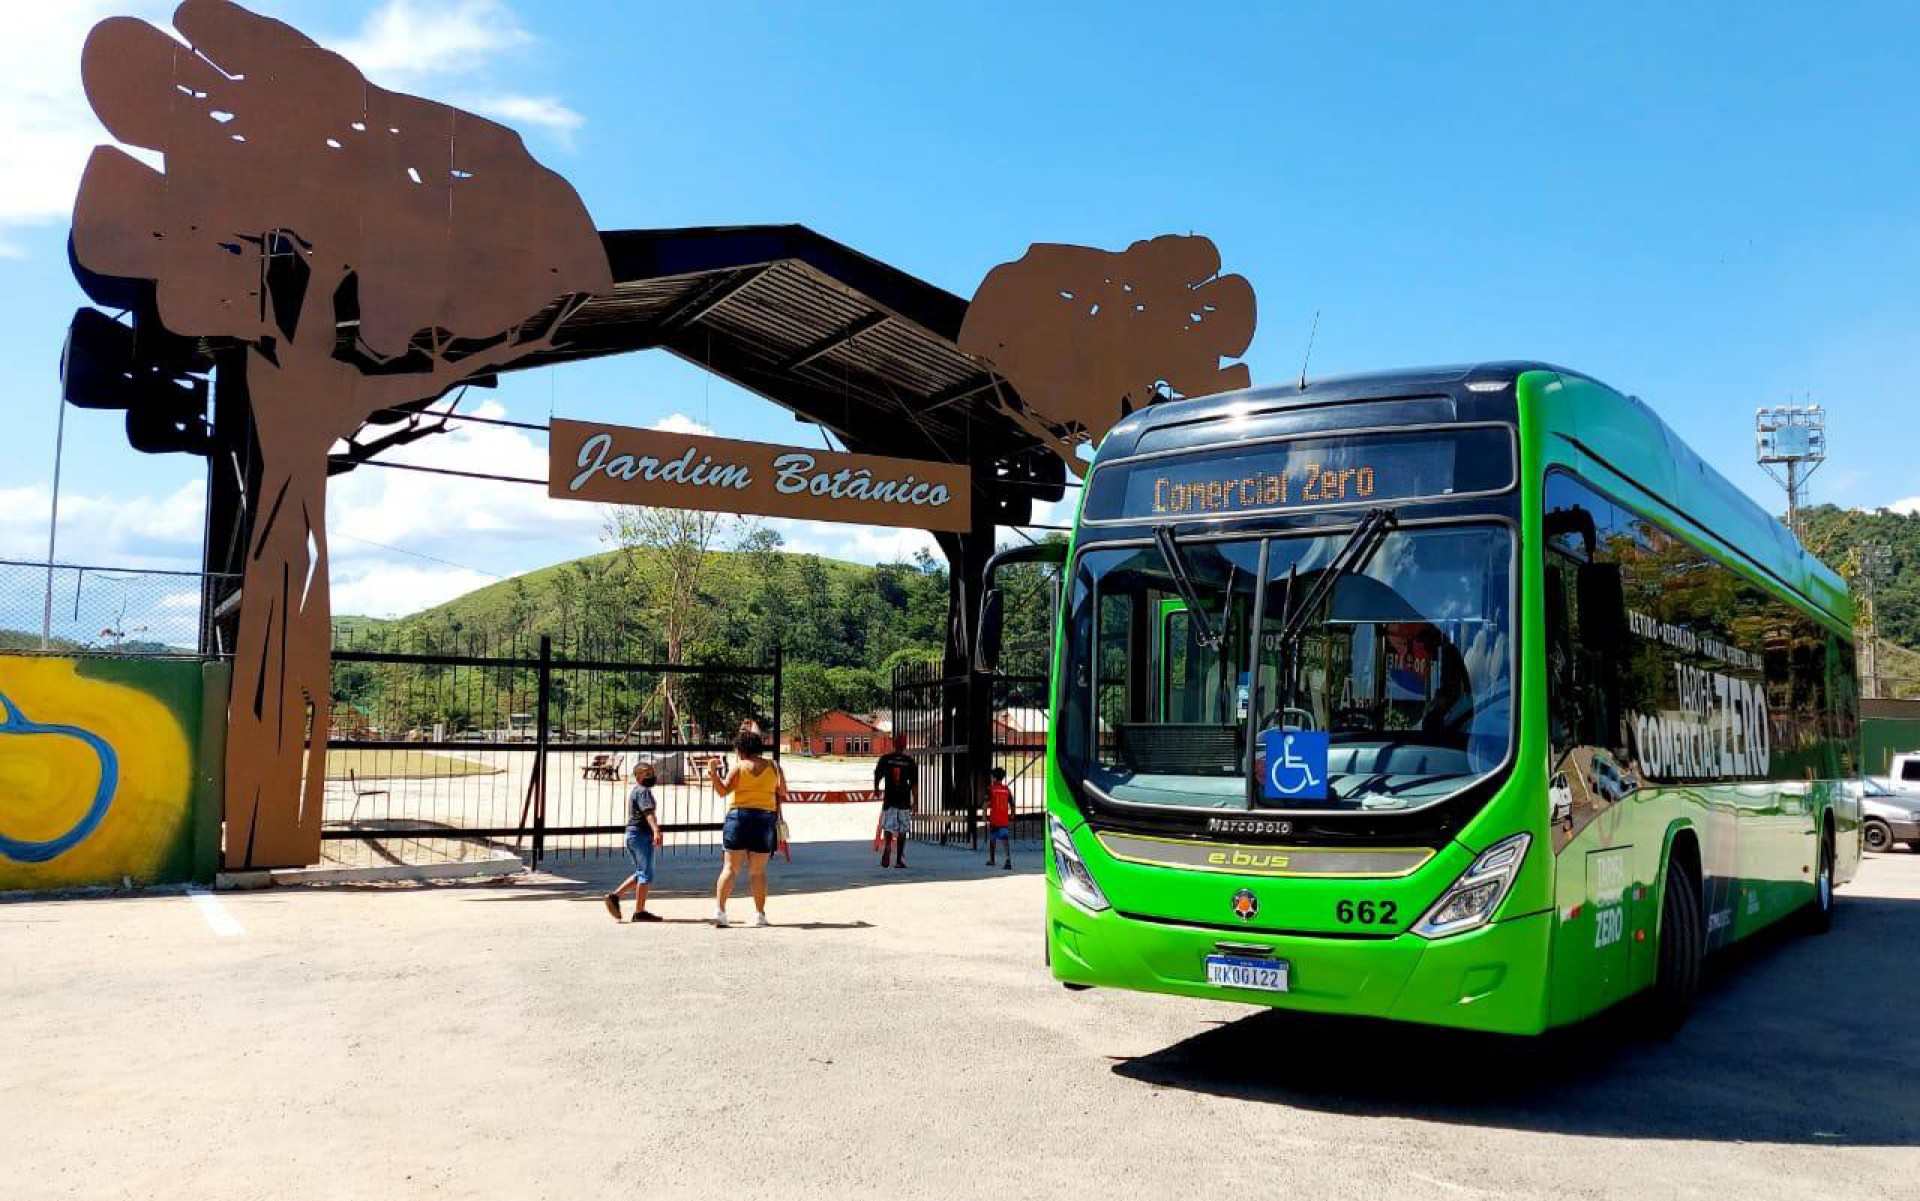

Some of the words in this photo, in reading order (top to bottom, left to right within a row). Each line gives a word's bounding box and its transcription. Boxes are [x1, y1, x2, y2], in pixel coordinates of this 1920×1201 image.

[567, 433, 752, 493] Jardim
[772, 453, 953, 507] Botânico
[1153, 469, 1288, 512] Comercial
[1302, 462, 1375, 502] Zero
[1674, 661, 1714, 718] TARIFA
[1637, 713, 1720, 778] COMERCIAL
[1715, 672, 1770, 777] ZERO
[1207, 817, 1293, 834] Marcopolo
[1207, 850, 1292, 868] e.bus
[1336, 900, 1398, 925] 662
[1594, 906, 1624, 949] ZERO
